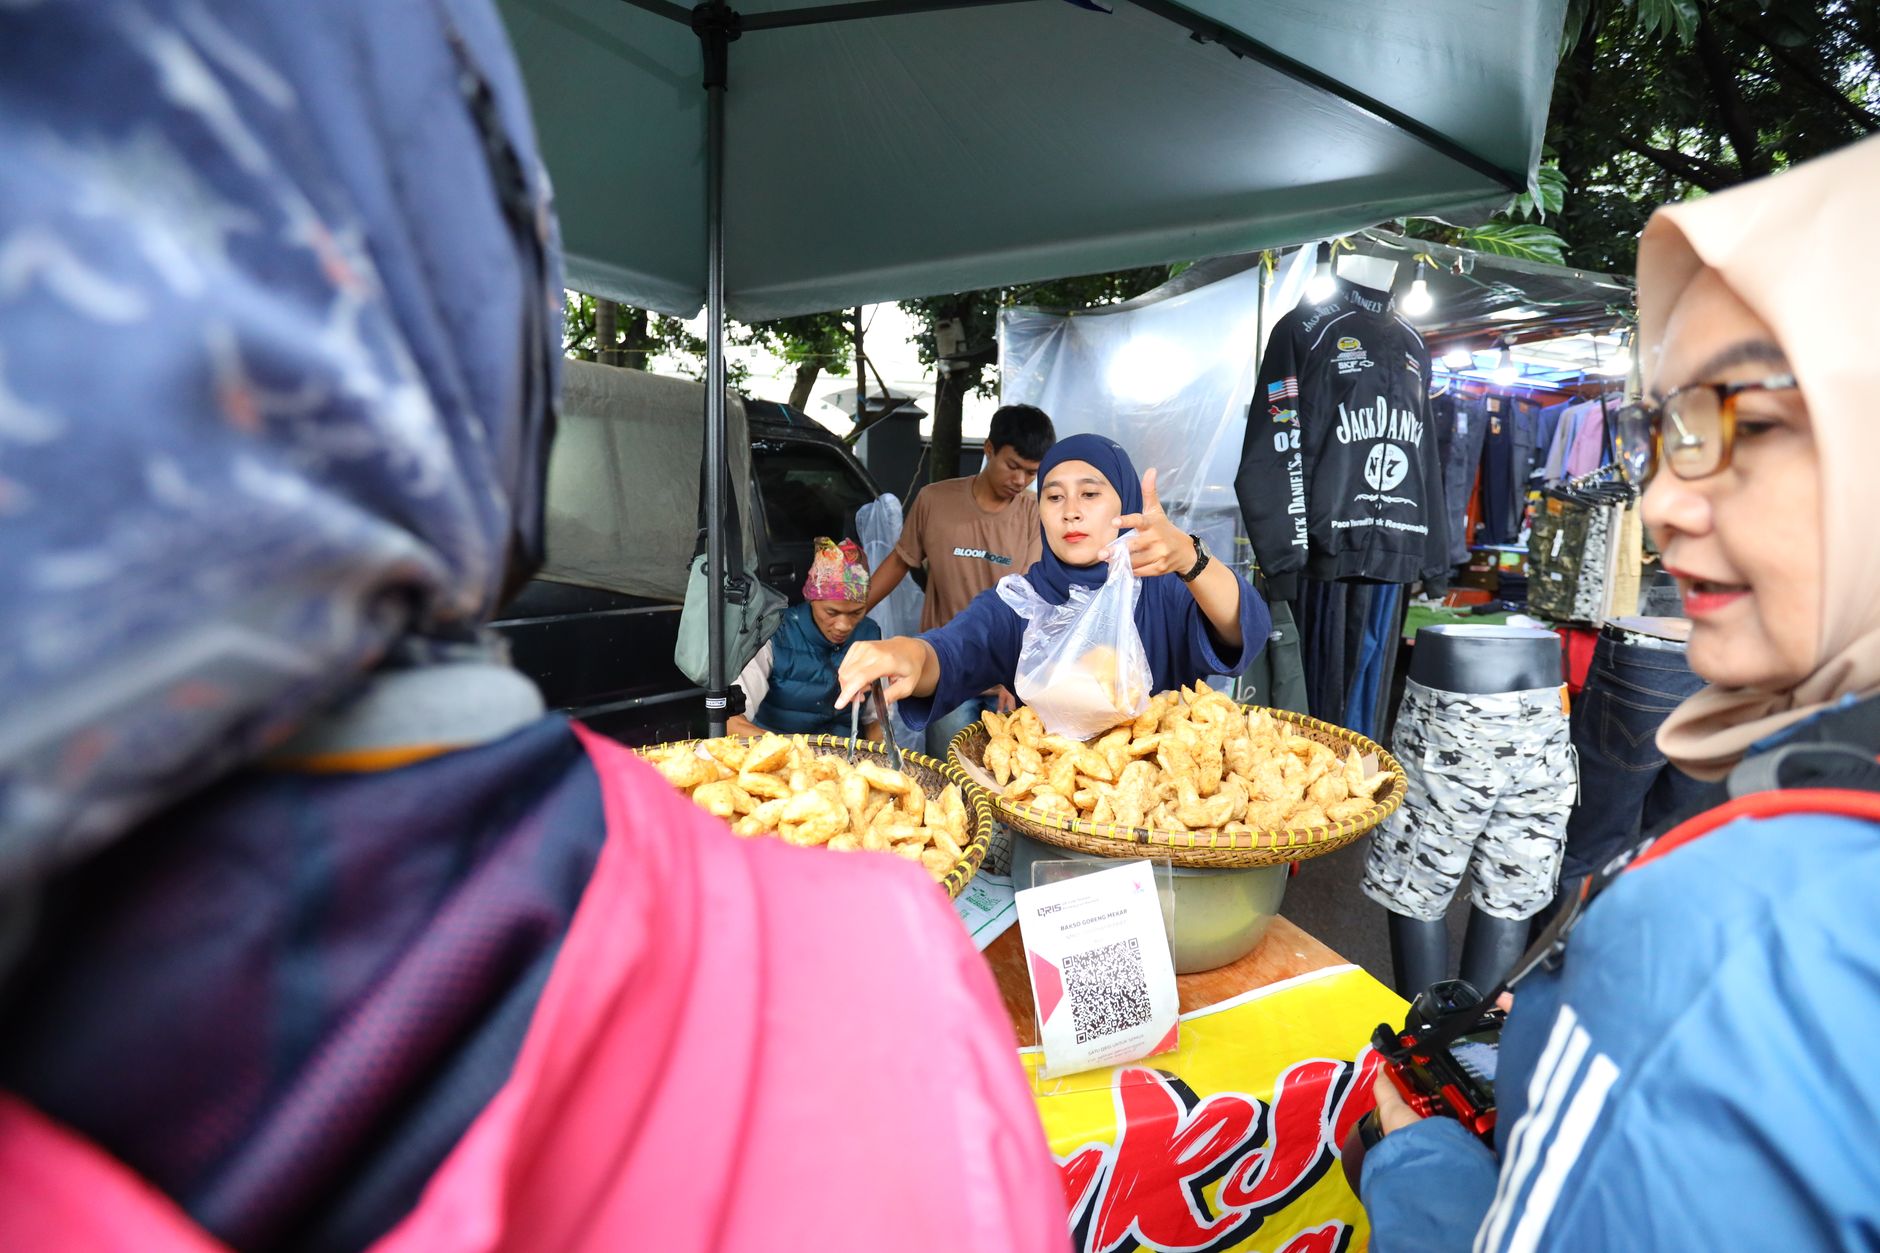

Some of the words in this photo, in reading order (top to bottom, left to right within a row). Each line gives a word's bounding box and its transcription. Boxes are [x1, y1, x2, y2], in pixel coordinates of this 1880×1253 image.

[1336, 402, 1376, 444] JACK
[1287, 455, 1306, 515] DANIEL'S
[1291, 517, 1309, 550] JACK
[1036, 903, 1062, 918] QRIS
[1060, 921, 1082, 932] BAKSO
[1081, 914, 1107, 926] GORENG
[1106, 908, 1128, 920] MEKAR
